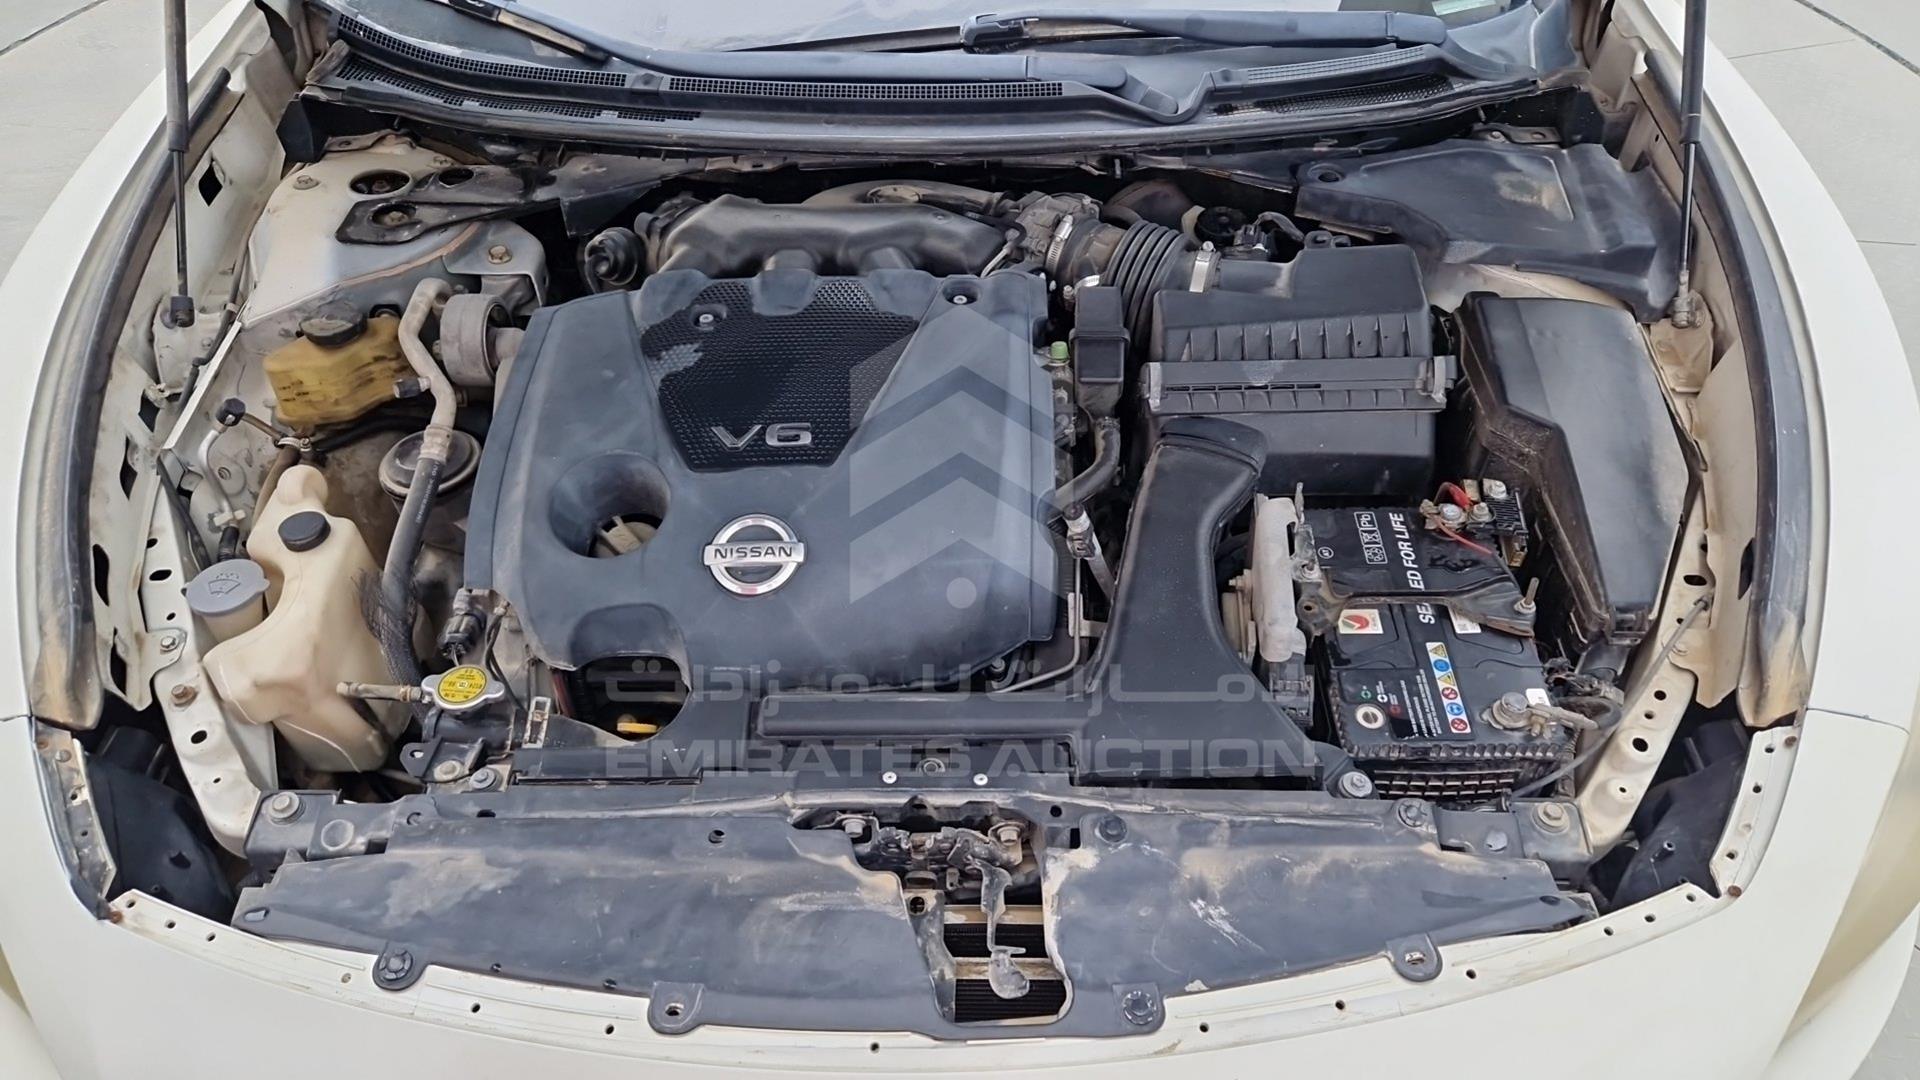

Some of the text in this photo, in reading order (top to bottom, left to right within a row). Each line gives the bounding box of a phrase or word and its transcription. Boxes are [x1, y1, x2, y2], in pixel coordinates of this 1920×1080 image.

[711, 422, 812, 450] V6
[1360, 513, 1372, 528] Pb
[1388, 512, 1411, 540] LIFE
[714, 545, 794, 560] NISSAN
[1397, 541, 1419, 569] FOR
